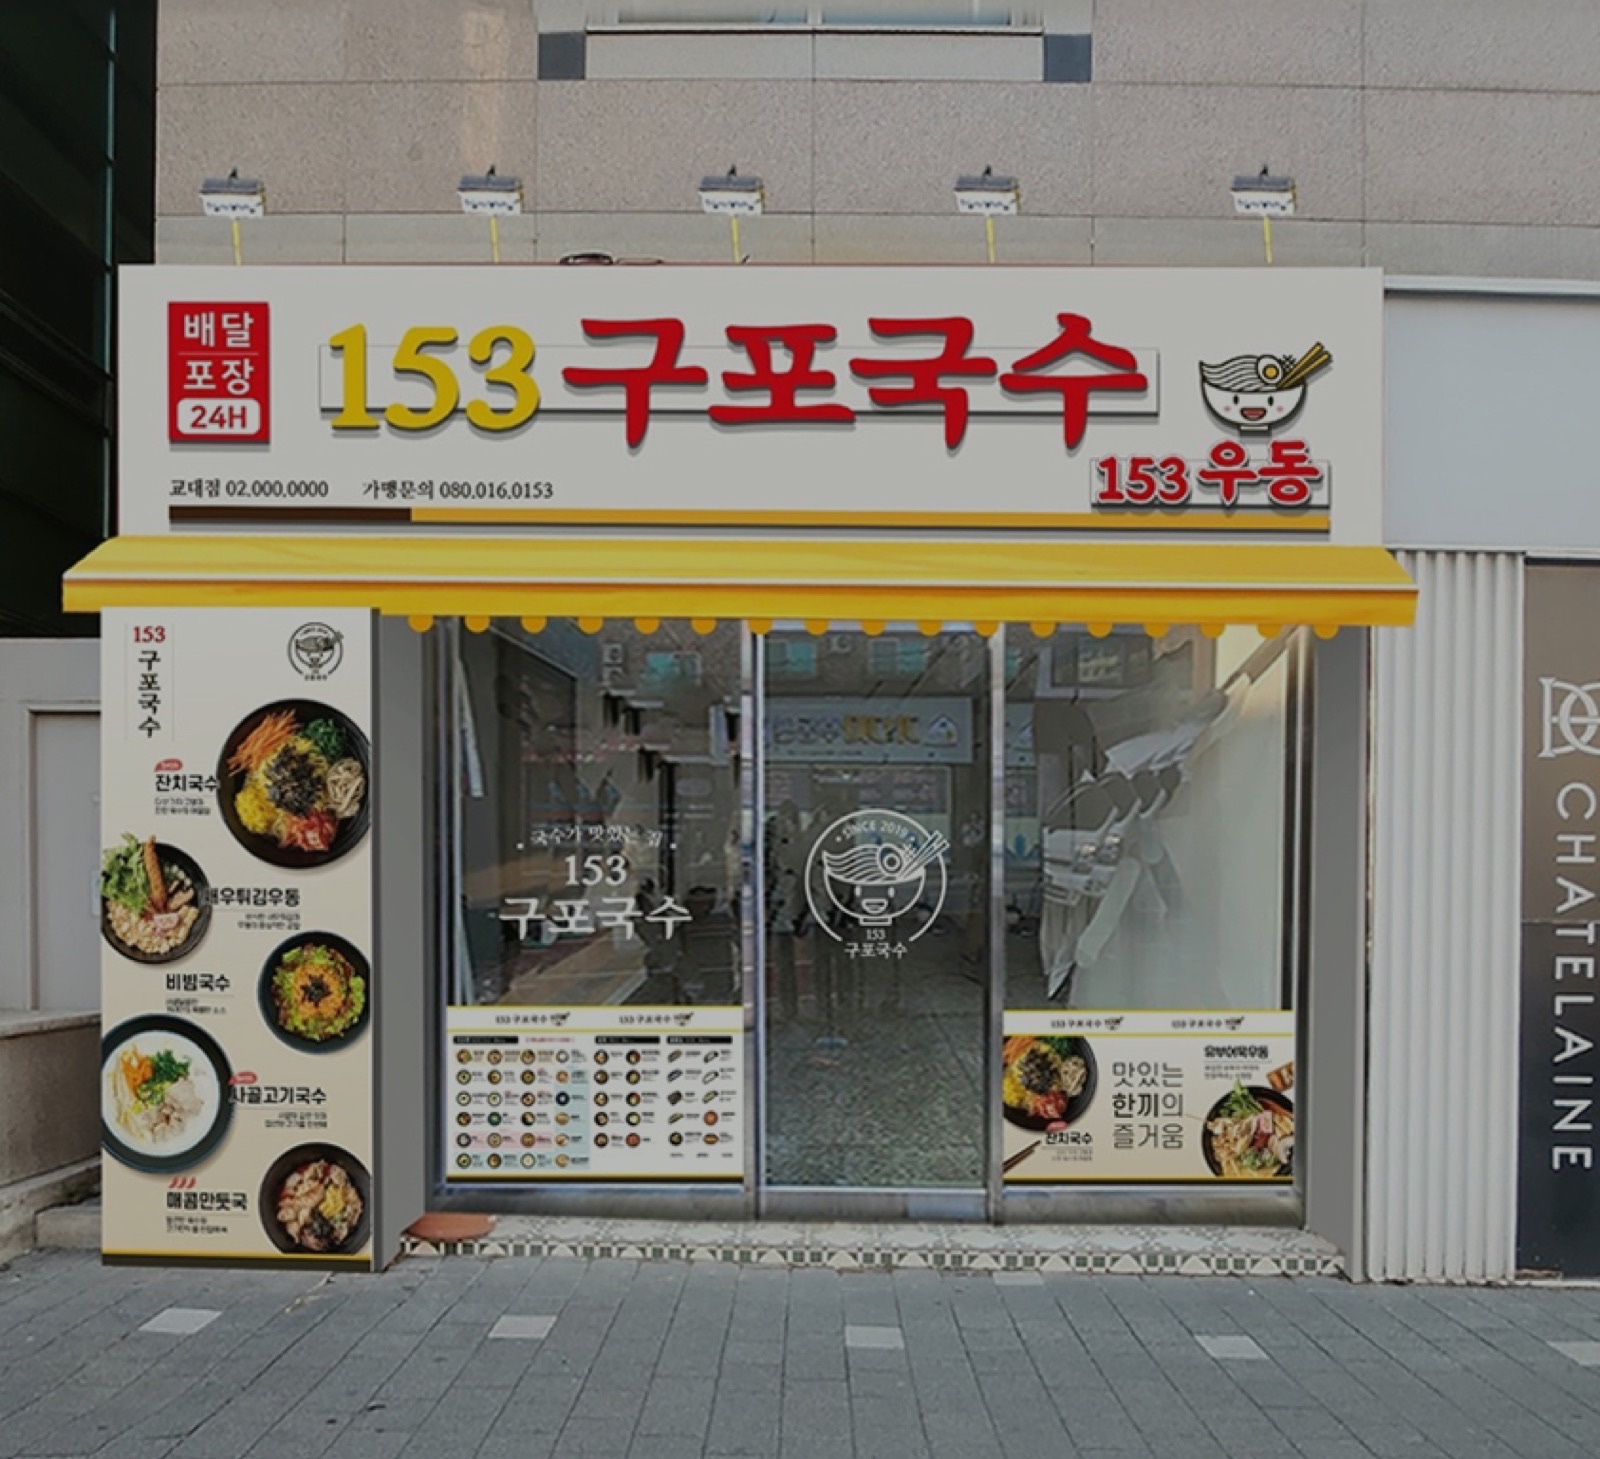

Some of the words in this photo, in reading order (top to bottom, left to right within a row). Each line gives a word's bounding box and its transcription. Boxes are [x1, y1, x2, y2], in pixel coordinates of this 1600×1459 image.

[183, 311, 254, 349] 배달
[183, 357, 254, 395] 포장
[328, 323, 540, 430] 153
[562, 312, 1148, 449] 구포국수
[190, 404, 248, 430] 24H
[1097, 456, 1189, 503] 153
[1198, 440, 1322, 505] 우동
[169, 478, 220, 498] 교대점
[225, 479, 329, 498] 02.000.0000
[362, 479, 433, 500] 가맹문의
[439, 481, 554, 500] 080.016.0153
[133, 626, 166, 643] 153
[138, 650, 161, 738] 구포국수
[155, 774, 219, 793] 잔치국수
[564, 854, 628, 887] 153
[499, 895, 694, 941] 구포국수
[866, 929, 886, 941] 153
[844, 942, 907, 959] 구포국수
[166, 974, 231, 992] 비빔국수
[1553, 782, 1597, 1171] CHATELAINE
[1112, 1061, 1184, 1088] 맛있는
[1112, 1092, 1184, 1119] 한끼의
[1112, 1123, 1184, 1150] 즐거움
